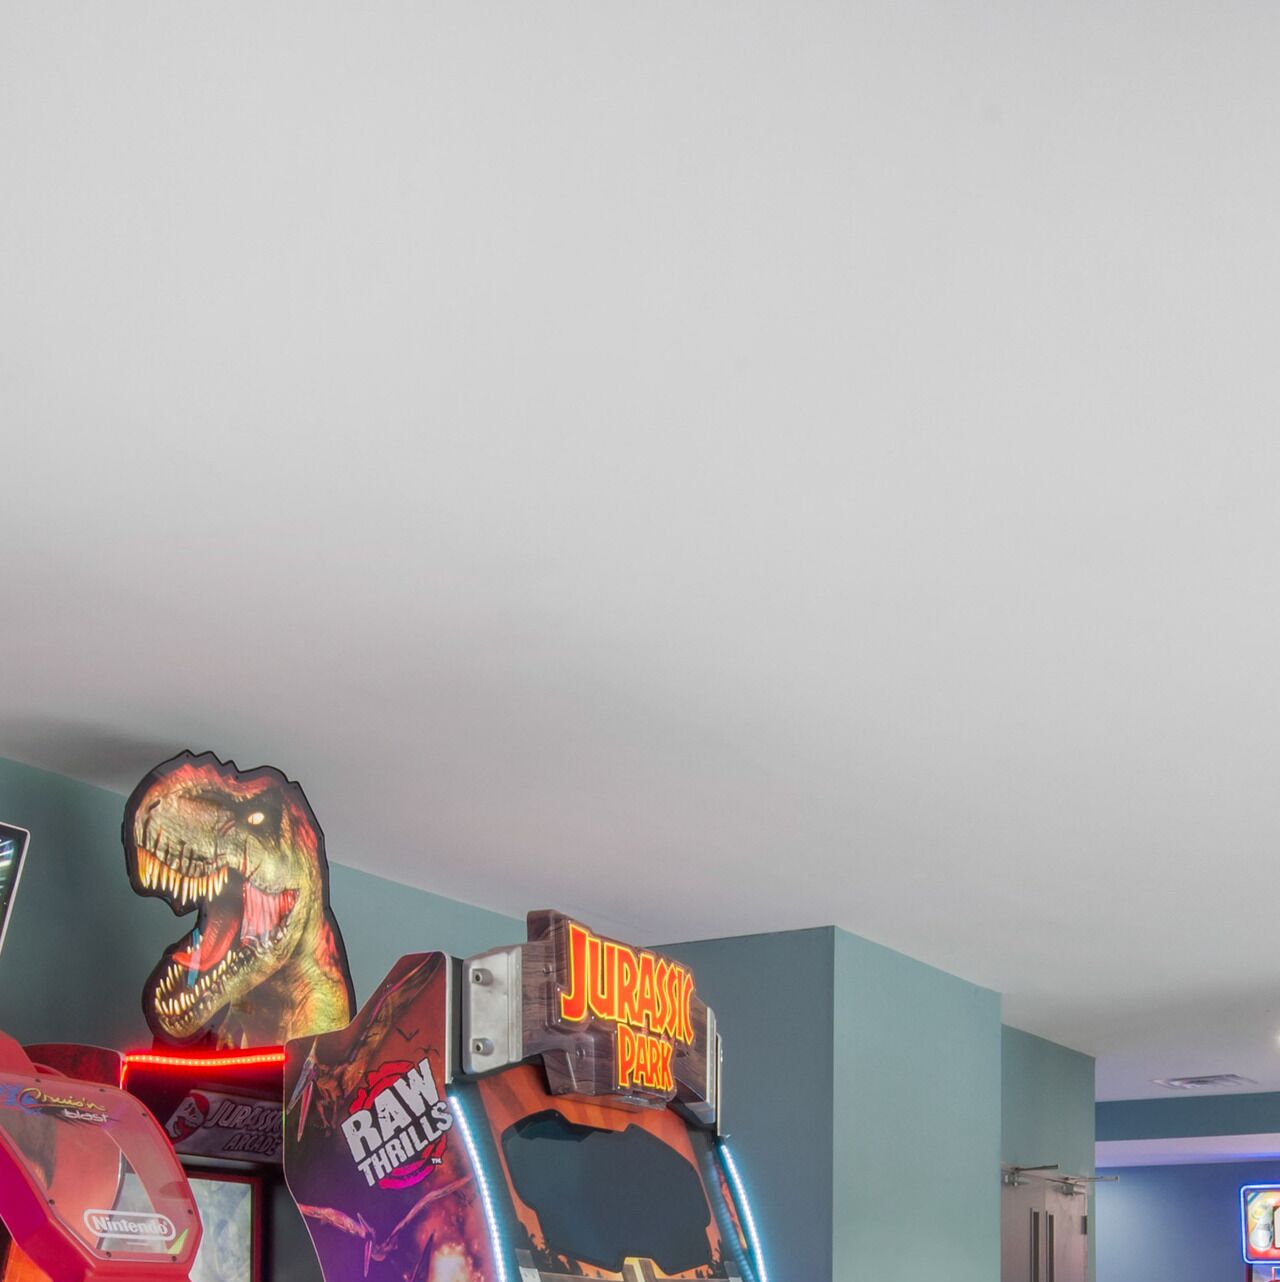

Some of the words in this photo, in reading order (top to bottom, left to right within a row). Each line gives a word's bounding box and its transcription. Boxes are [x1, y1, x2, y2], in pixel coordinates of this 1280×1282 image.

[560, 923, 694, 1045] JURASSIC
[617, 1024, 673, 1092] PARK
[64, 1109, 109, 1122] blast
[341, 1058, 439, 1163] RAW
[358, 1102, 453, 1187] THRILLS
[93, 1216, 167, 1234] Nintendo
